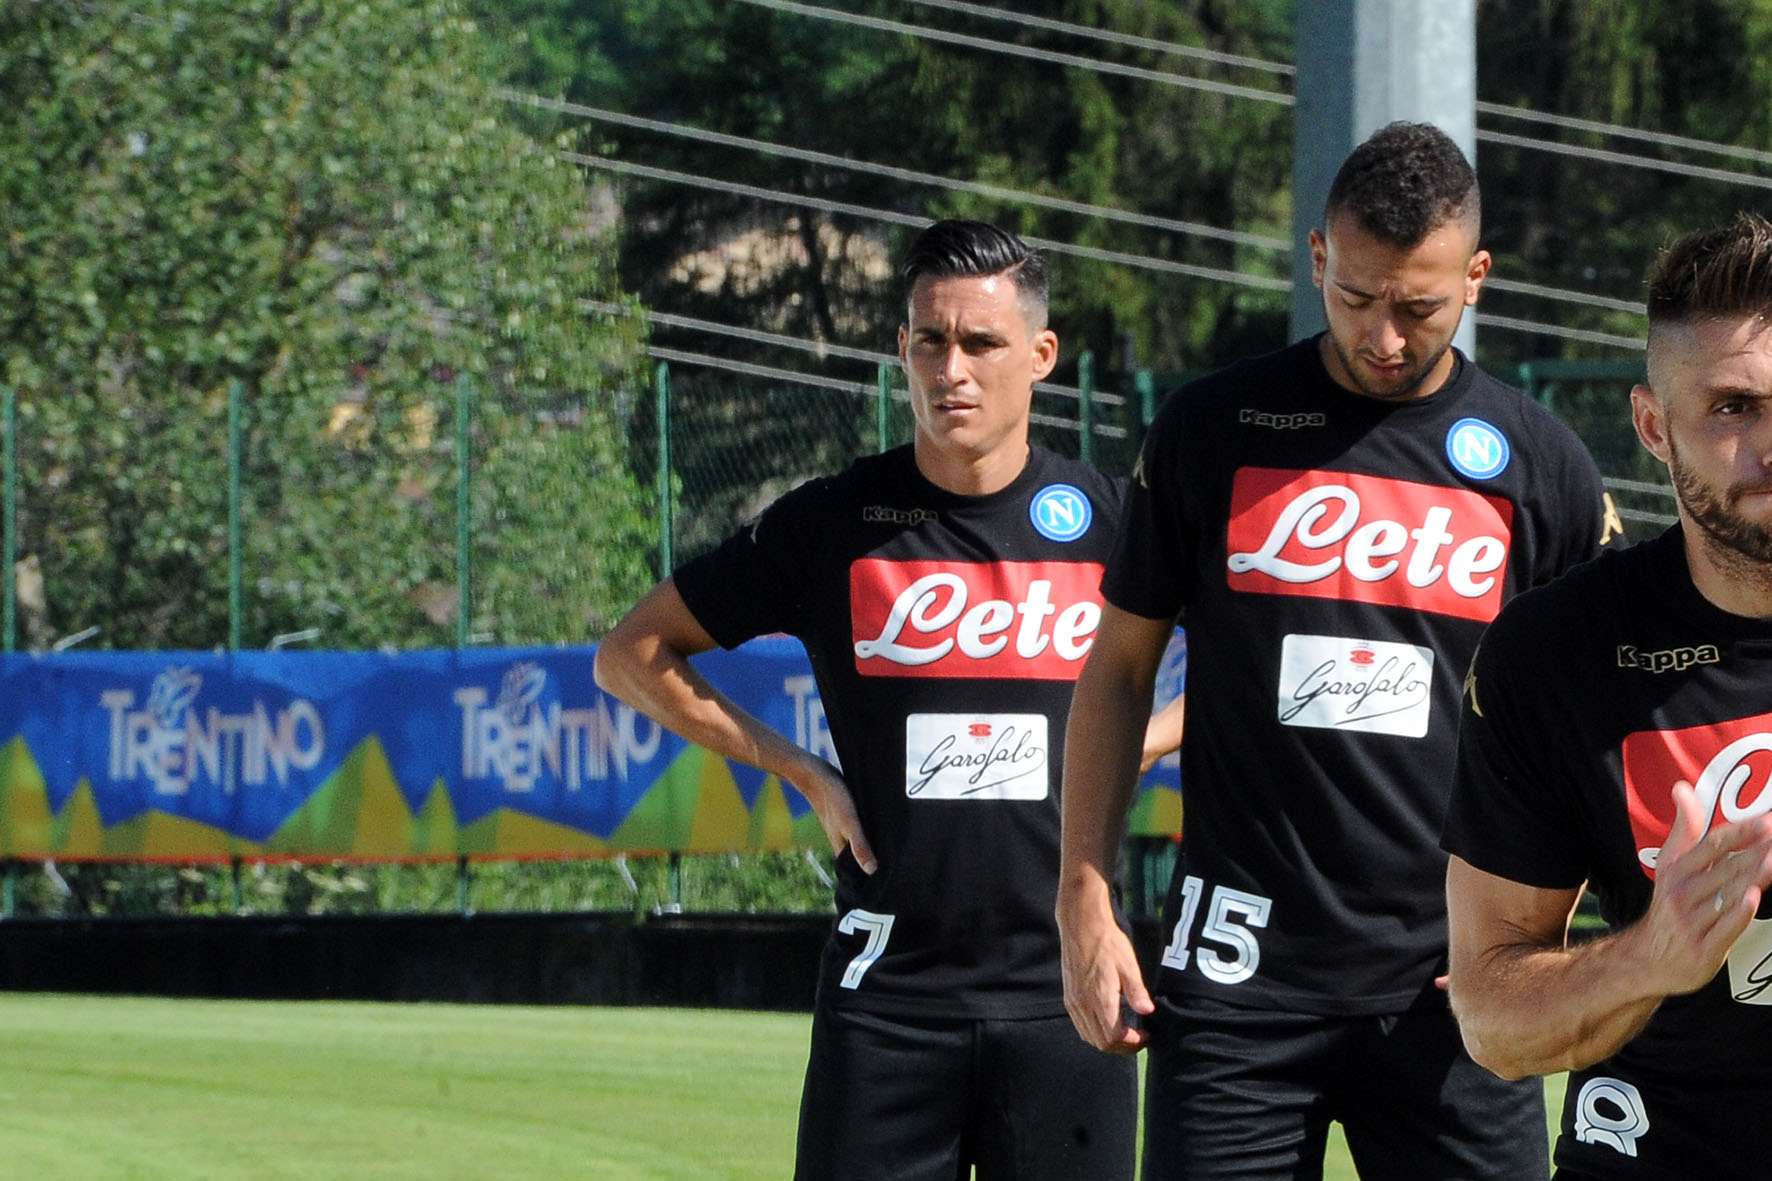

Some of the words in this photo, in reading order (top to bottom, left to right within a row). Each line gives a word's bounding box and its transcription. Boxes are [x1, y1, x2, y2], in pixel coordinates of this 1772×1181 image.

[1240, 409, 1325, 429] Kappa
[1462, 431, 1491, 464] N
[863, 505, 938, 526] Kappa
[1044, 498, 1074, 526] N
[1228, 485, 1506, 598] Lete
[855, 573, 1102, 665] Lete
[1280, 656, 1428, 725] Garofalo
[1617, 645, 1719, 674] Kappa
[98, 690, 325, 796] TRENTINO
[453, 685, 662, 793] TRENTINO
[908, 726, 1046, 796] Garofalo
[837, 909, 896, 990] 7
[1161, 875, 1273, 985] 15
